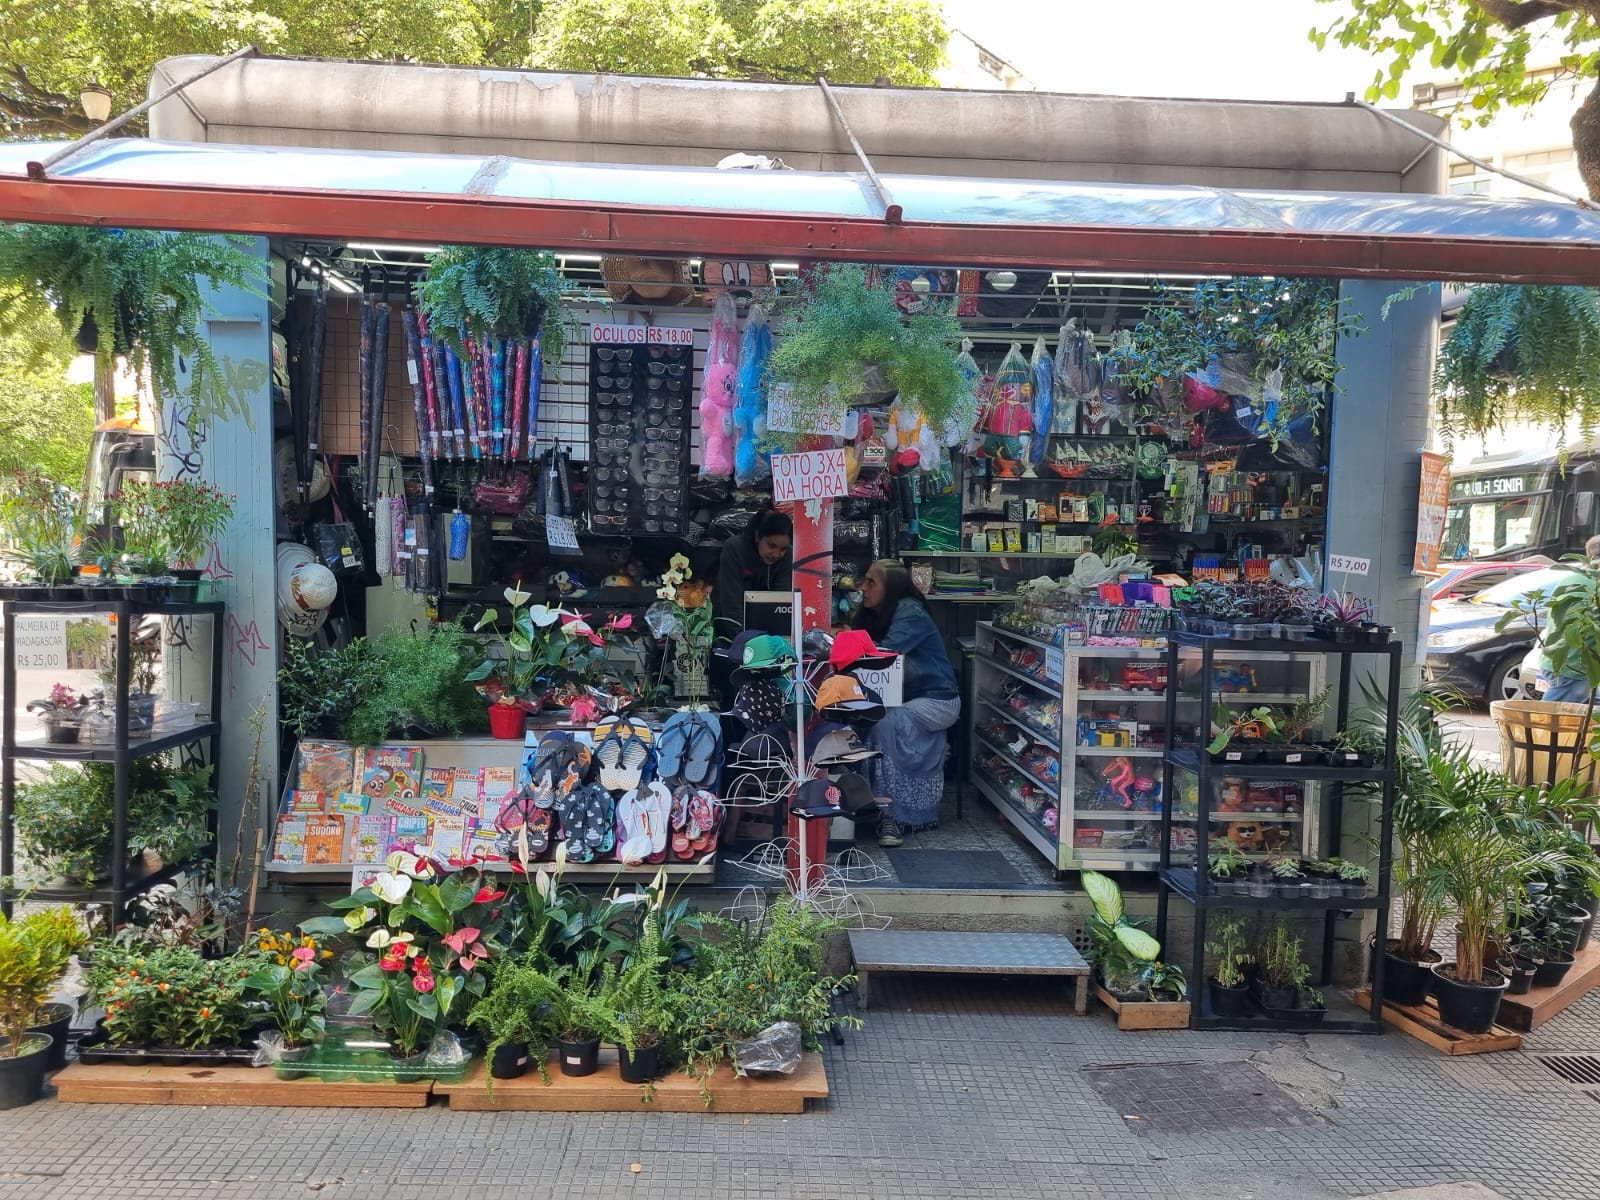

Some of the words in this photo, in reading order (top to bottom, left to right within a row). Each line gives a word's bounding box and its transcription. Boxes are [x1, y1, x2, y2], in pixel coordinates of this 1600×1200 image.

[649, 328, 662, 342] R$
[666, 329, 692, 344] 18,00
[772, 454, 811, 477] FOTO
[817, 451, 845, 474] 3X4
[776, 479, 796, 500] NA
[801, 474, 844, 498] HORA
[1472, 480, 1490, 495] VILA
[1493, 477, 1523, 494] SONIA
[1331, 557, 1342, 568] R$
[1345, 560, 1367, 571] 7,00
[16, 621, 48, 631] PALMEIRA
[50, 620, 60, 631] DE
[16, 636, 63, 647] MADAGASCAR
[33, 654, 59, 667] 25,00
[860, 671, 890, 684] VON
[425, 798, 460, 816] CRUZADAS
[310, 825, 341, 836] SUDOKU
